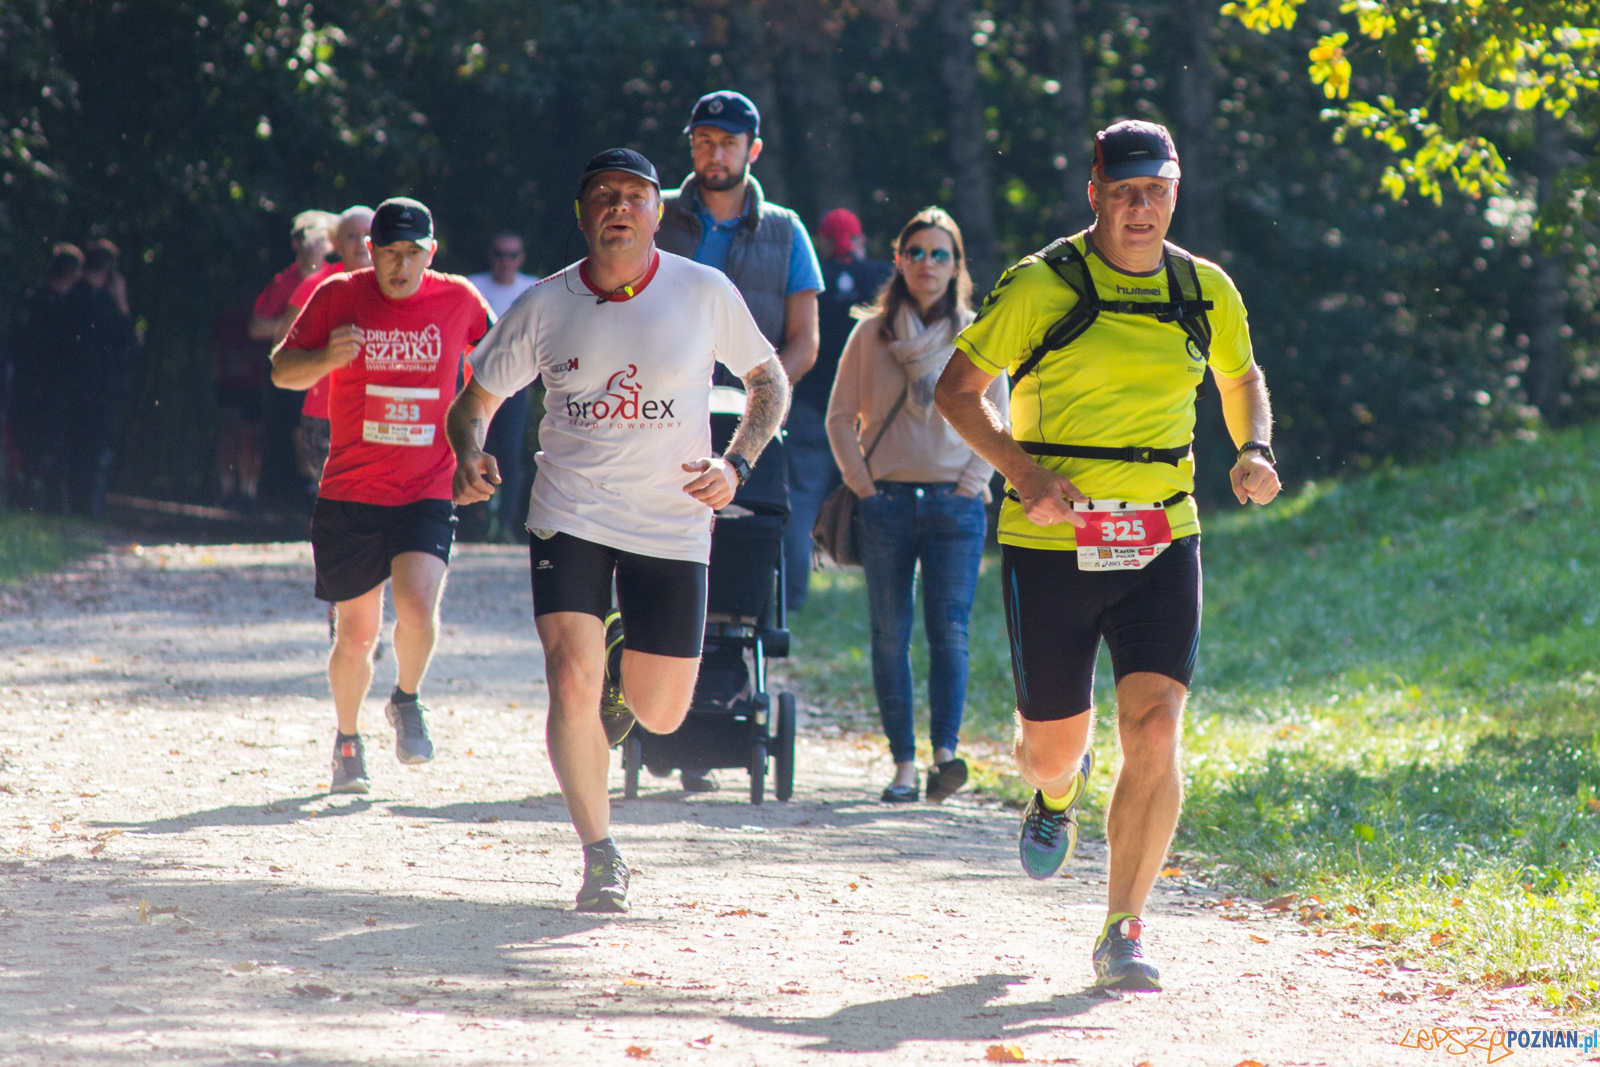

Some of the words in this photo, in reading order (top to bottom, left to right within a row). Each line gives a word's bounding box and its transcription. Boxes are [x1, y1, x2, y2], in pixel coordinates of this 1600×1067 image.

[1116, 284, 1161, 296] hummel
[366, 328, 428, 343] DRUŻYNA
[365, 341, 441, 361] SZPIKU
[384, 403, 420, 422] 253
[566, 391, 675, 420] brodex
[568, 418, 599, 430] sklep
[609, 420, 682, 430] rowerowy
[1101, 519, 1146, 542] 325
